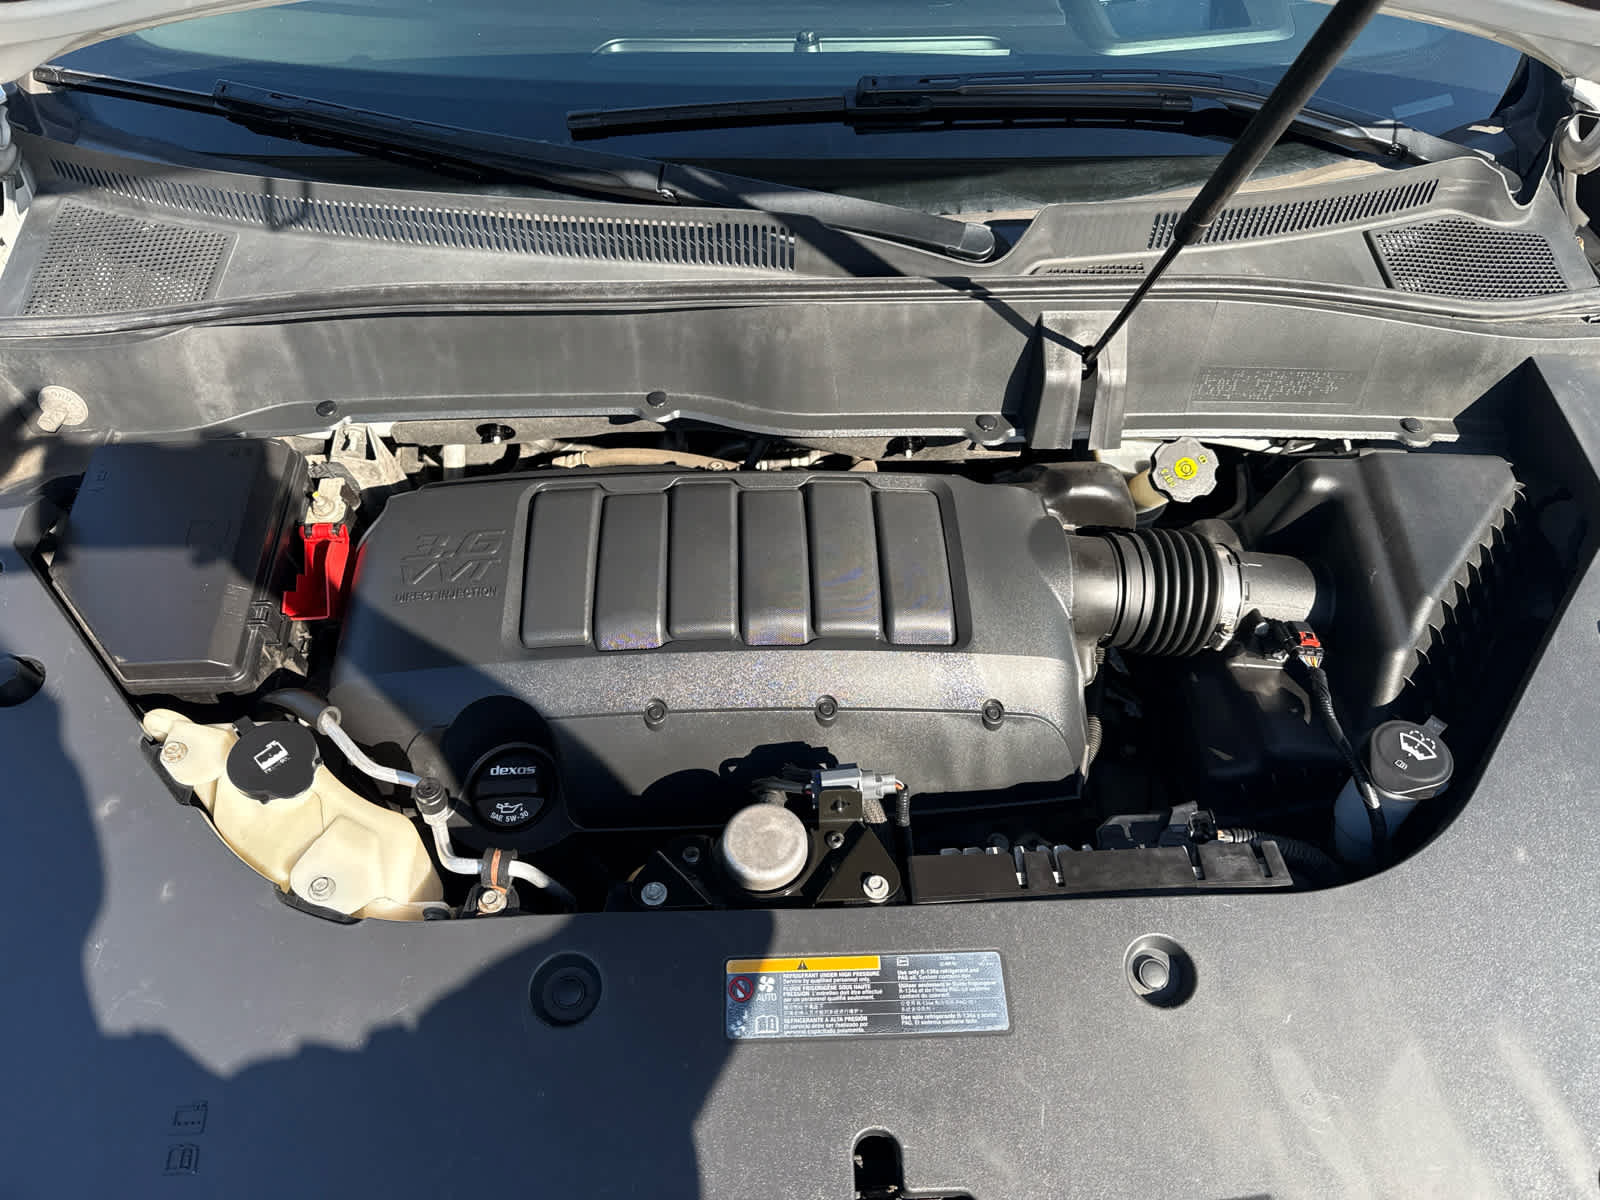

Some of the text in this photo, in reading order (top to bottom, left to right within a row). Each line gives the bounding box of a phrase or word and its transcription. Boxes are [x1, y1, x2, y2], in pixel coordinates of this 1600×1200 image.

[393, 586, 497, 603] DIRECT INJECTION
[490, 765, 536, 776] dexos
[490, 810, 529, 822] SAE 5W-30
[756, 993, 777, 1002] AUTO
